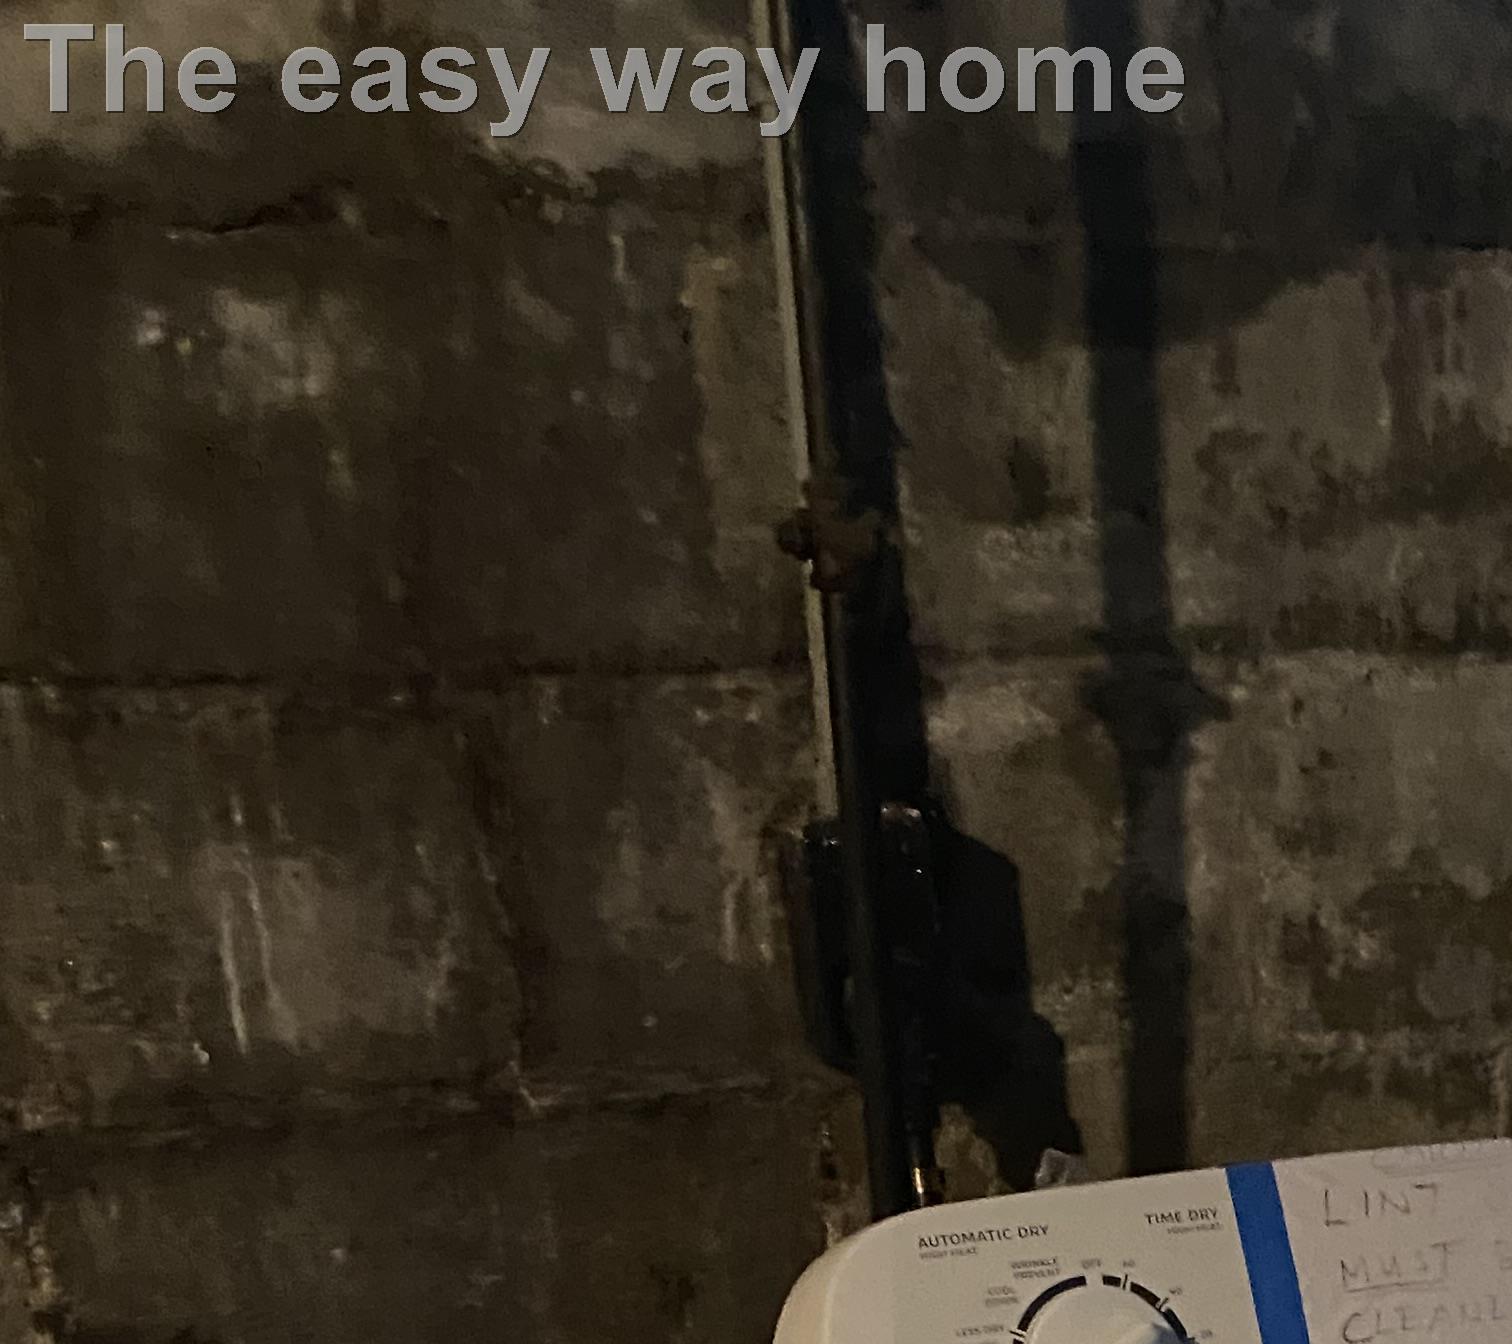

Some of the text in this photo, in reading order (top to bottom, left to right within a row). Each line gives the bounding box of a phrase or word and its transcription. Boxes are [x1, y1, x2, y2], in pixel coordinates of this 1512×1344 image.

[1144, 1207, 1219, 1226] TIME DRY
[1323, 1180, 1440, 1228] LINT
[918, 1223, 1050, 1250] AUTOMATIC DRY
[1340, 1240, 1458, 1284] MUST
